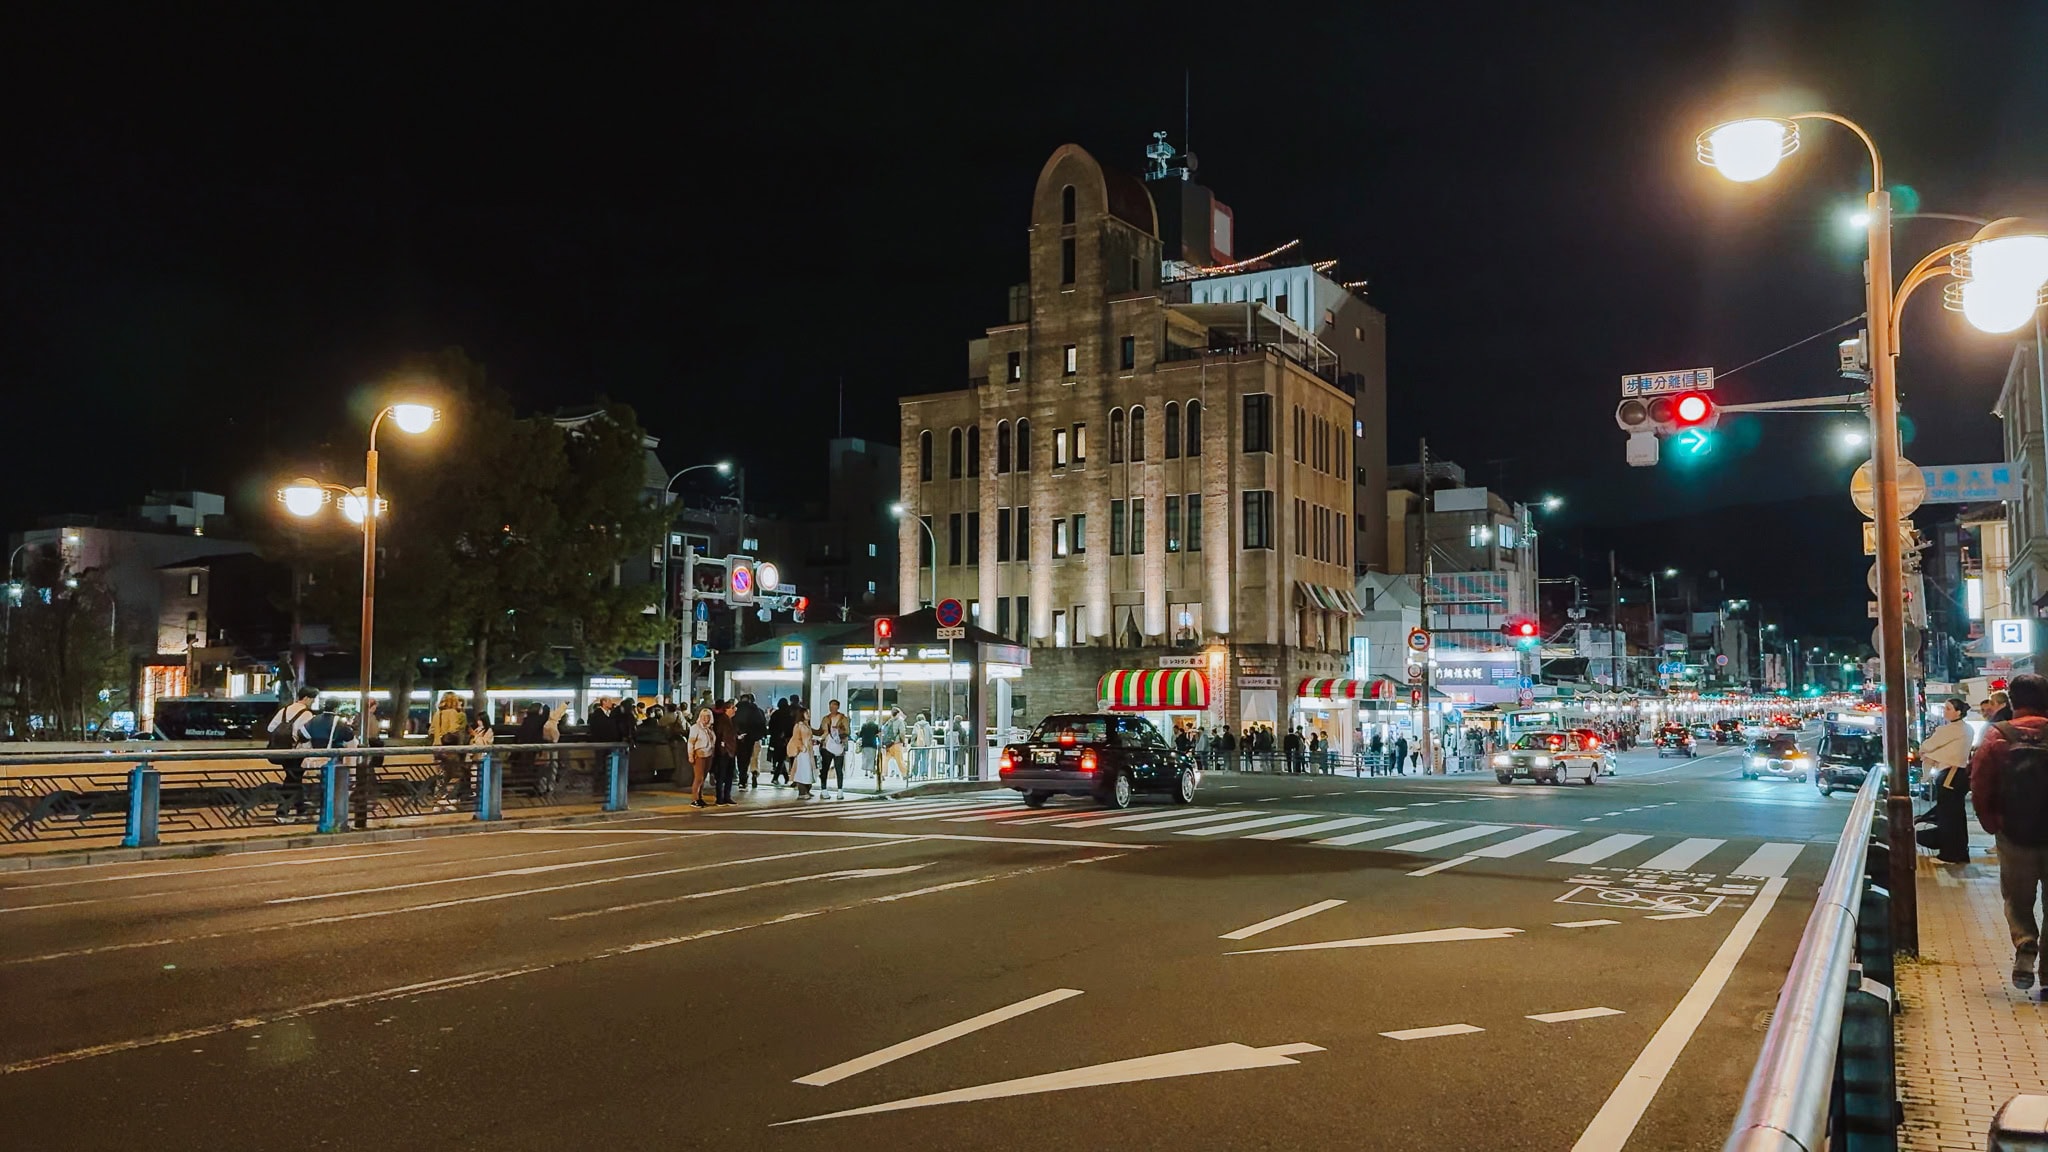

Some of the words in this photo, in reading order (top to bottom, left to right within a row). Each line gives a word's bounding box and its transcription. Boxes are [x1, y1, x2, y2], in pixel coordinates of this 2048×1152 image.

[1626, 372, 1709, 393] 歩車分離信号
[938, 629, 963, 637] ここまで
